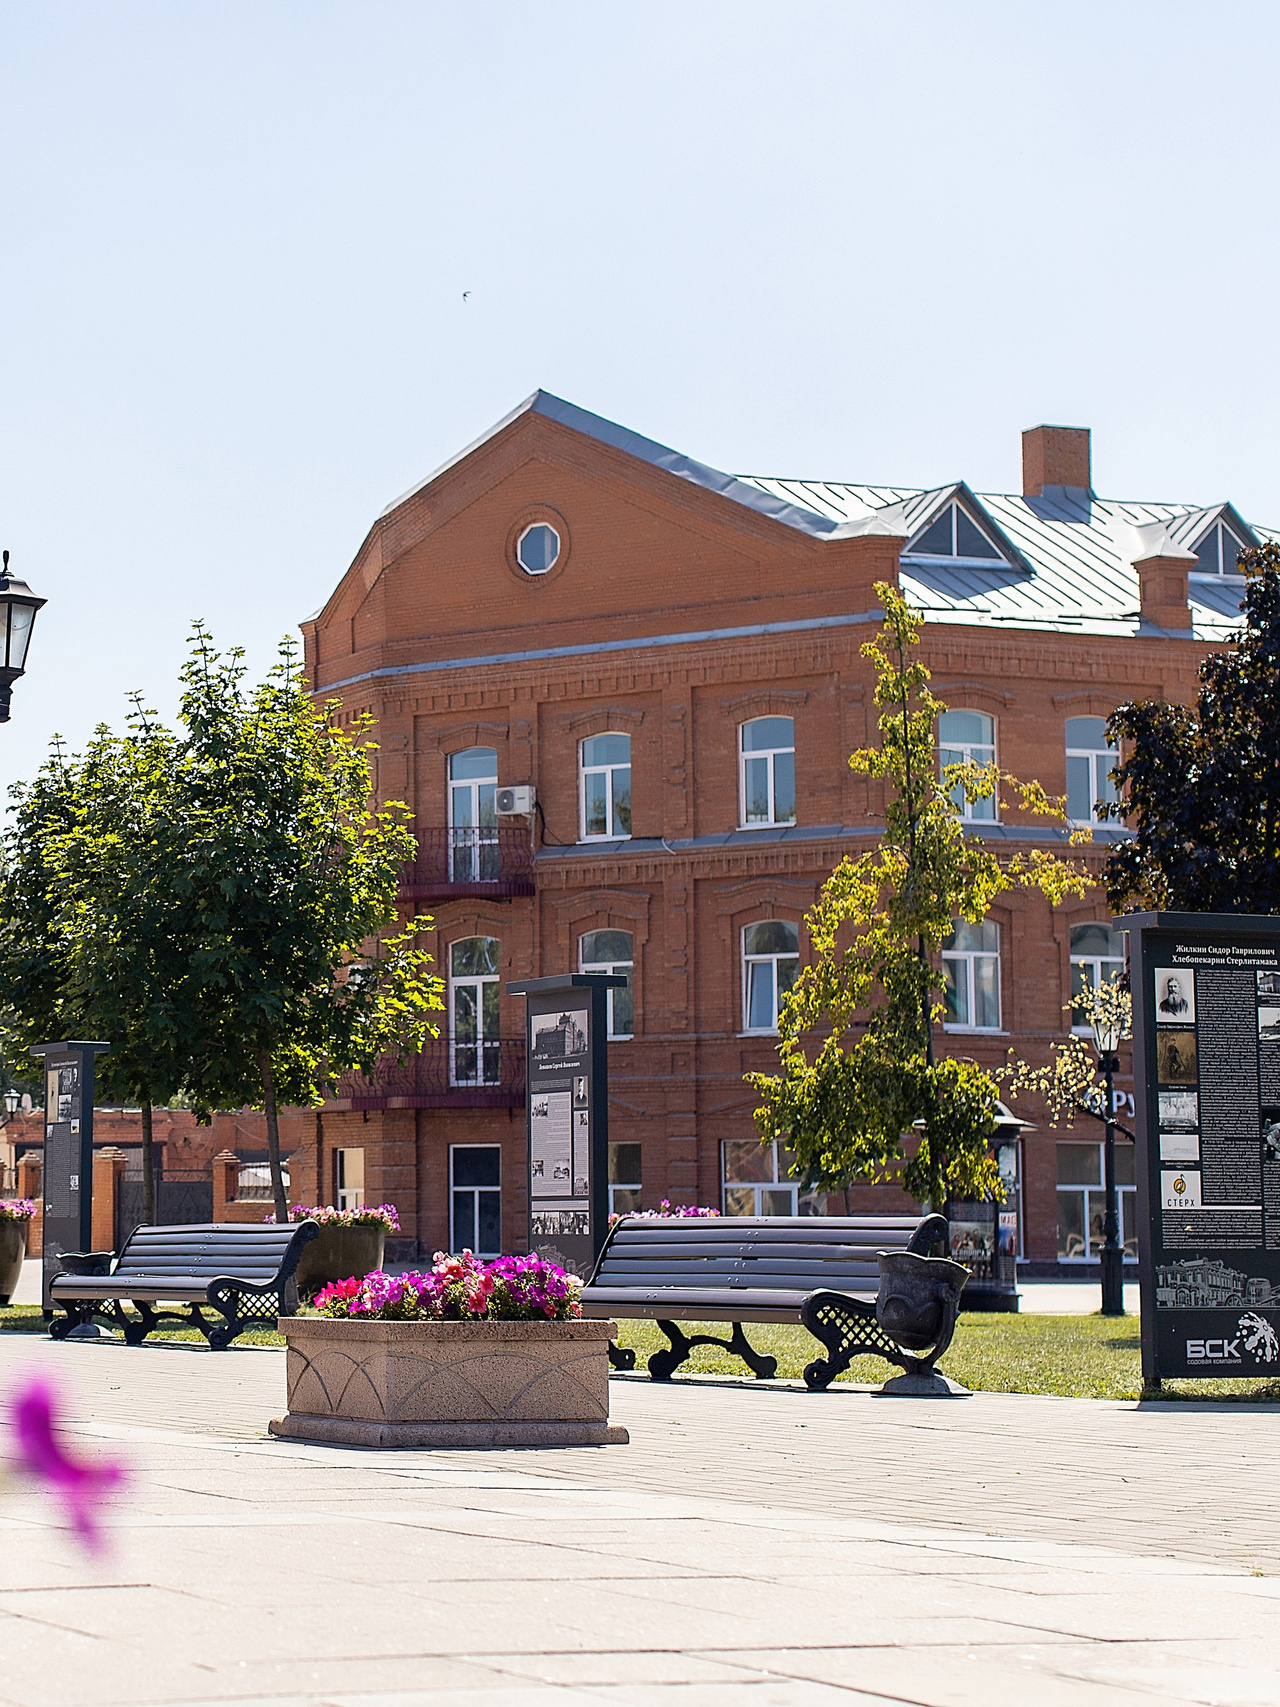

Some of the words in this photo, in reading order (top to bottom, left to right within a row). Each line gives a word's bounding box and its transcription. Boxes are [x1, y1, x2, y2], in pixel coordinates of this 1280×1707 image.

[1175, 944, 1207, 953] Жилкин
[1208, 945, 1231, 956] Сидор
[1231, 946, 1275, 957] Гаврилович
[1171, 955, 1226, 966] Хлебопекарни
[1226, 956, 1278, 967] Стерлитамака
[1167, 1198, 1195, 1207] СТЕРХ
[1186, 1339, 1241, 1358] БСК
